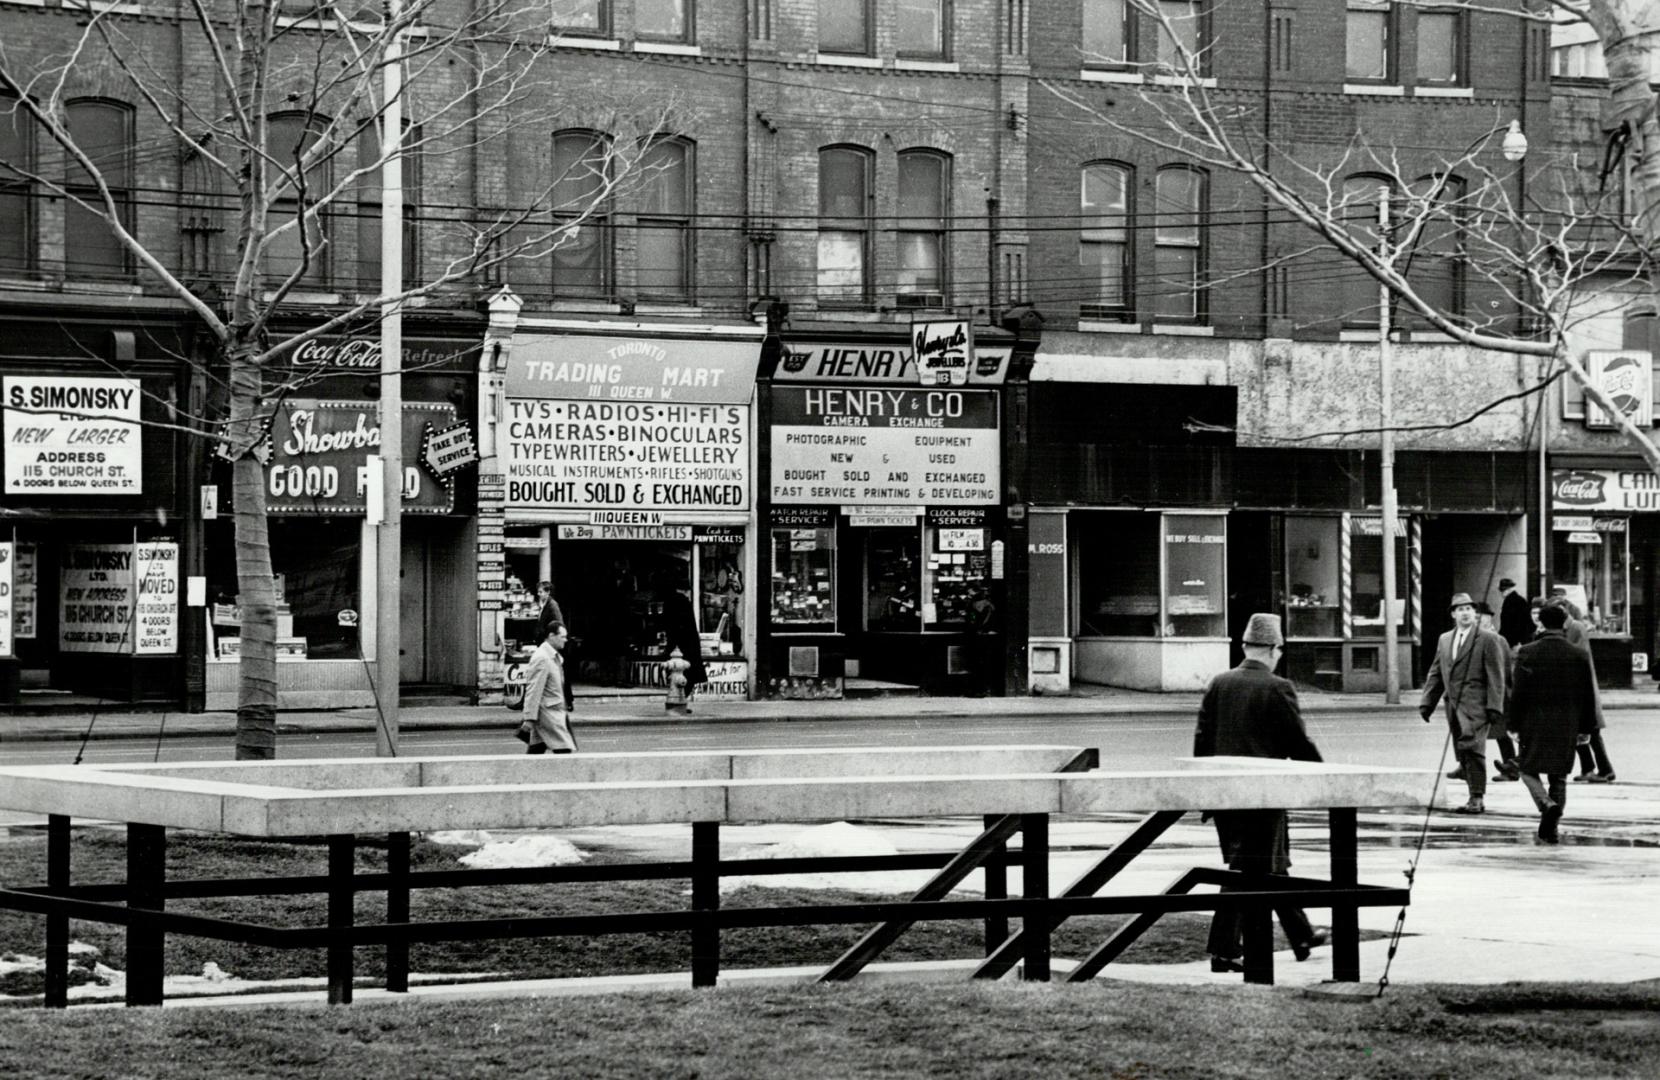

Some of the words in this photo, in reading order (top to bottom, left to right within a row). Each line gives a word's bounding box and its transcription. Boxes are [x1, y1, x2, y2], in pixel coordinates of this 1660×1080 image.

[608, 341, 666, 361] TORONTO
[816, 348, 912, 378] HENRY
[526, 361, 622, 384] TRADING
[662, 367, 724, 387] MART
[610, 385, 653, 399] QUEEN
[806, 389, 905, 416] HENRY
[911, 398, 919, 410] &
[927, 392, 963, 417] CO
[510, 401, 550, 419] TV'S
[568, 403, 654, 422] RADIOS
[823, 416, 869, 427] CAMERA
[889, 417, 944, 428] EXCHANGE
[12, 427, 54, 444] NEW
[66, 427, 130, 445] LARGER
[283, 409, 382, 455] Showba
[510, 422, 606, 441] CAMERAS
[618, 425, 742, 444] BINOCULARS
[431, 438, 452, 452] TAKE
[453, 431, 469, 445] OUT
[786, 433, 867, 446] PHOTOGRAPHIC
[914, 436, 972, 447] EQUIPMENT
[36, 452, 106, 463] ADDRESS
[437, 446, 471, 466] SERVICE
[510, 442, 626, 462] TYPEWRITERS
[637, 446, 738, 464] JEWELLERY
[830, 453, 854, 463] NEW
[882, 454, 890, 464] &
[929, 454, 956, 464] USED
[24, 465, 43, 477] 115
[49, 465, 103, 478] CHURCH
[108, 466, 126, 478] ST.
[509, 464, 557, 477] MUSICAL
[563, 466, 643, 479] INSTRUMENTS
[650, 467, 686, 480] RIFLES
[694, 468, 742, 481] SHOTGUNS
[784, 469, 826, 481] BOUGHT
[843, 471, 870, 482] SOLD
[887, 472, 909, 482] AND
[925, 473, 986, 484] EXCHANGED
[91, 480, 118, 488] QUEEN
[269, 464, 339, 498] GOOD
[357, 465, 420, 499] FD
[584, 482, 625, 504] SOLD
[633, 483, 645, 504] &
[653, 483, 742, 506] EXCHANGED
[774, 486, 803, 497] FAST
[811, 487, 856, 498] SERVICE
[863, 488, 910, 499] PRINTING
[918, 488, 926, 498] &
[931, 488, 995, 500] DEVELOPING
[606, 512, 648, 524] QUEEN
[651, 513, 661, 524] W
[929, 509, 956, 517] CLOCK
[778, 517, 819, 525] SERVICE
[563, 527, 574, 537] We
[577, 525, 593, 539] Buy
[602, 526, 687, 539] PAWNTICKETS
[694, 534, 744, 543] PAWNTICKETS
[480, 544, 502, 552] RIFLES
[140, 579, 175, 594] MOVED
[79, 605, 115, 624] CHURCH
[148, 617, 171, 625] DOORS
[146, 628, 167, 637] BELOW
[140, 638, 161, 647] QUEEN
[507, 664, 530, 682] Ca
[706, 668, 727, 678] ash
